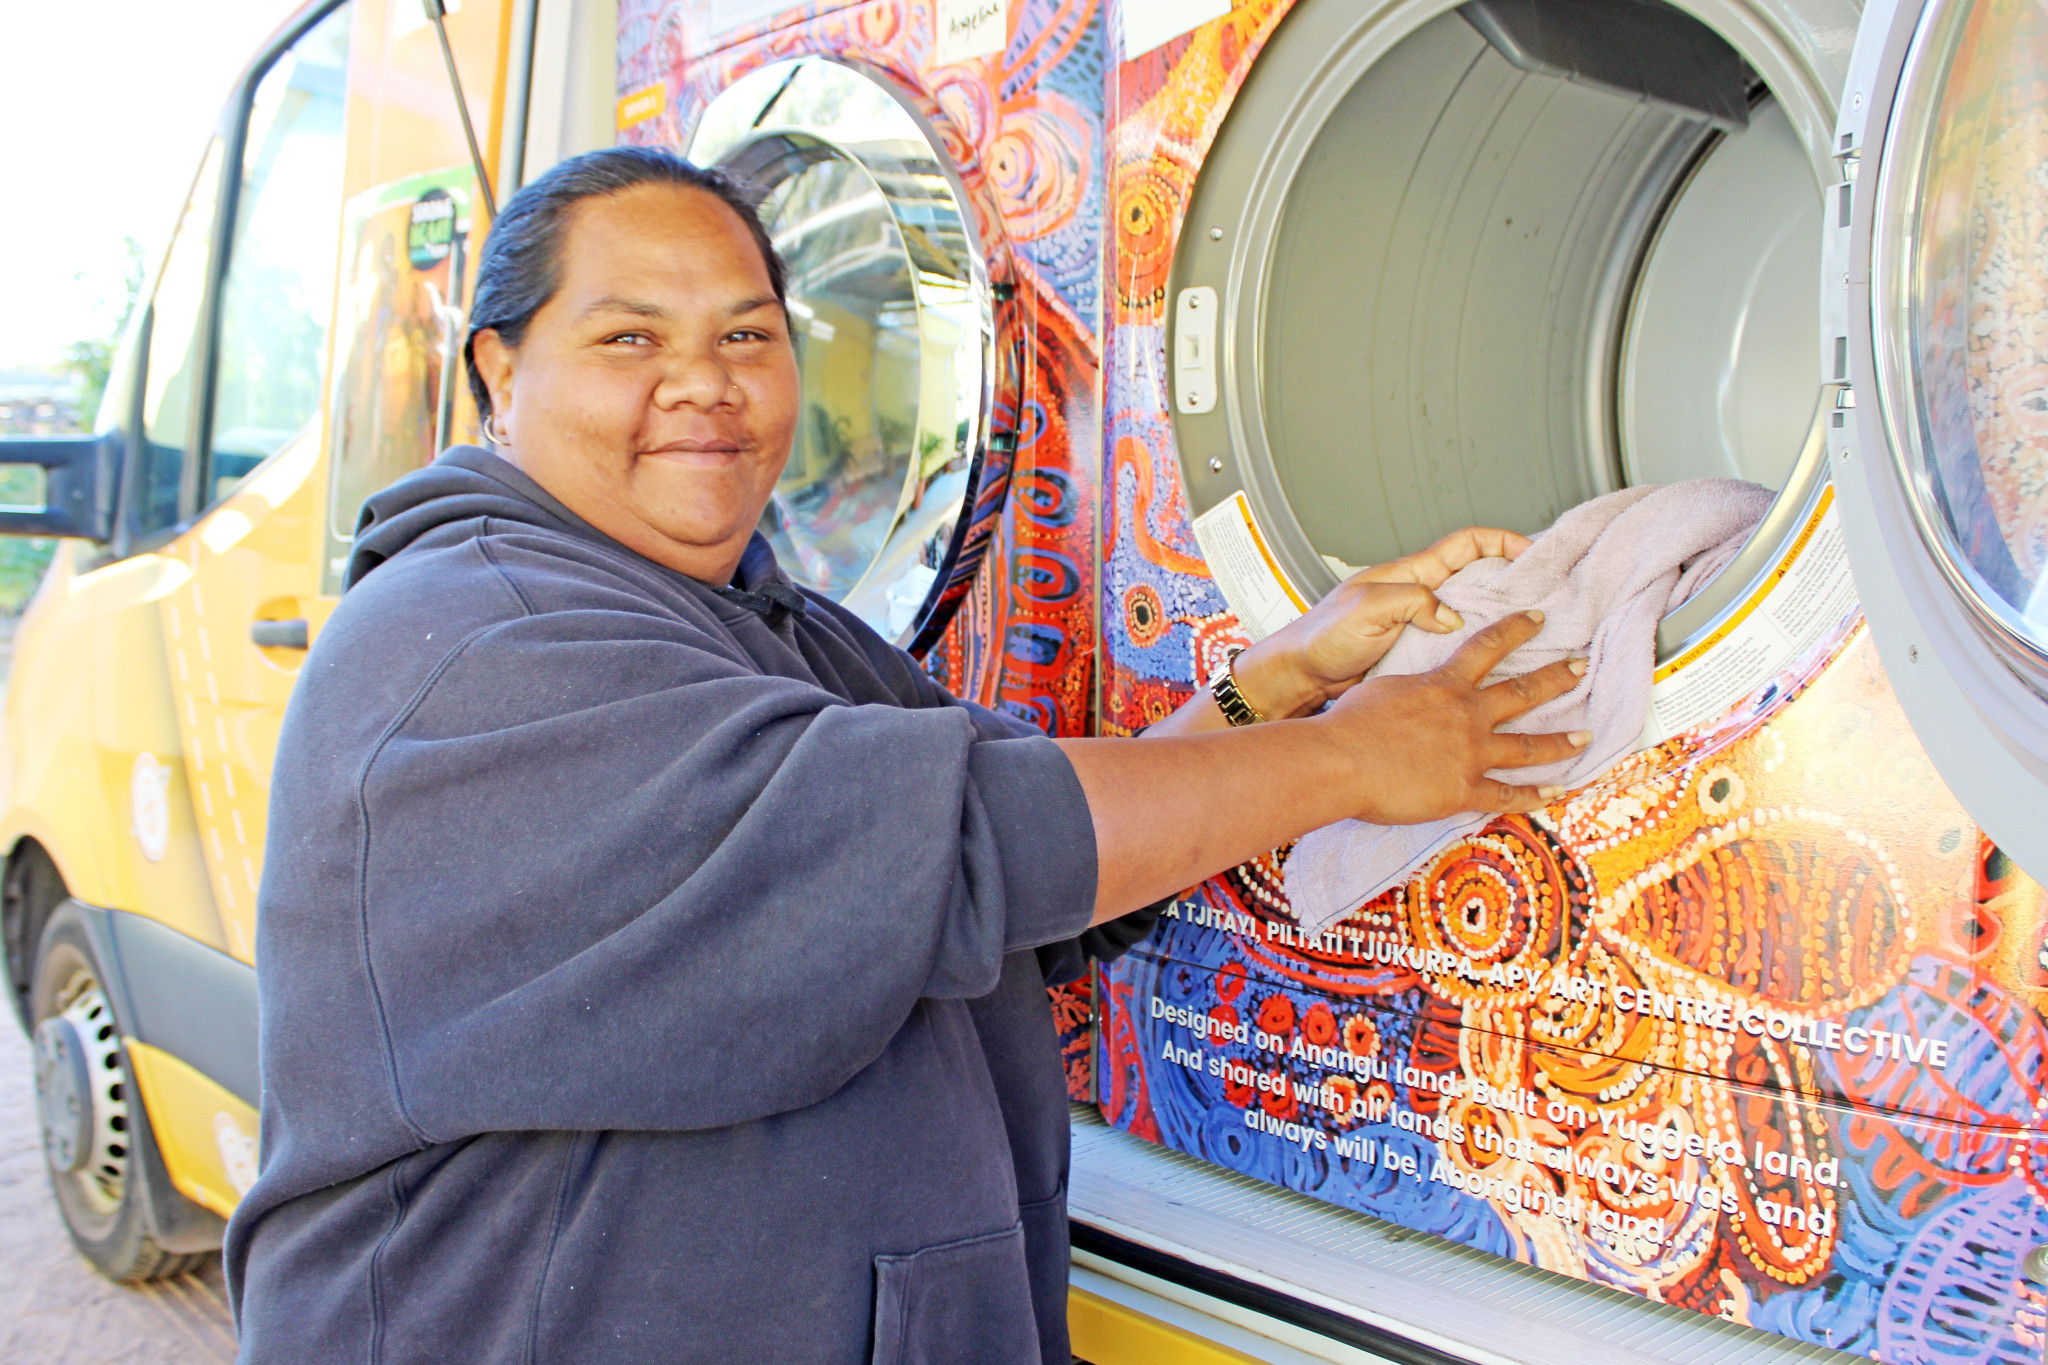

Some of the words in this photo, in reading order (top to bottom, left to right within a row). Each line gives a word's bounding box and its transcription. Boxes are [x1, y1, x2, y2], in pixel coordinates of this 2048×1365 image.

[1785, 513, 1821, 567] AVERTISSEMENT
[1680, 632, 1723, 666] ADVERTENCIA
[1185, 902, 1262, 944] TJITAYI,
[1267, 921, 1343, 956] PILTATI
[1349, 936, 1481, 982] TJUKURPA.
[1488, 961, 1542, 993] APY
[1549, 974, 1606, 1005] ART
[1613, 985, 1732, 1031] CENTRE
[1741, 1009, 1948, 1068] COLLECTIVE
[1151, 996, 1249, 1045] Designed
[1255, 1031, 1284, 1054] on
[1396, 1059, 1463, 1099] land.
[1472, 1078, 1538, 1117] Built
[1546, 1100, 1586, 1129] on
[1596, 1106, 1742, 1165] Yuggera
[1754, 1140, 1849, 1190] land.
[1162, 1040, 1203, 1072] And
[1208, 1056, 1287, 1097] shared
[1292, 1081, 1344, 1113] with
[1351, 1096, 1383, 1123] all
[1389, 1101, 1466, 1145] lands
[1473, 1123, 1537, 1164] that
[1544, 1146, 1659, 1197] always
[1669, 1177, 1747, 1222] was,
[1758, 1198, 1833, 1237] and
[1244, 1108, 1328, 1153] always
[1333, 1135, 1376, 1165] will
[1383, 1143, 1422, 1183] be,
[1429, 1158, 1580, 1223] Aboriginal
[1591, 1199, 1673, 1248] land.
